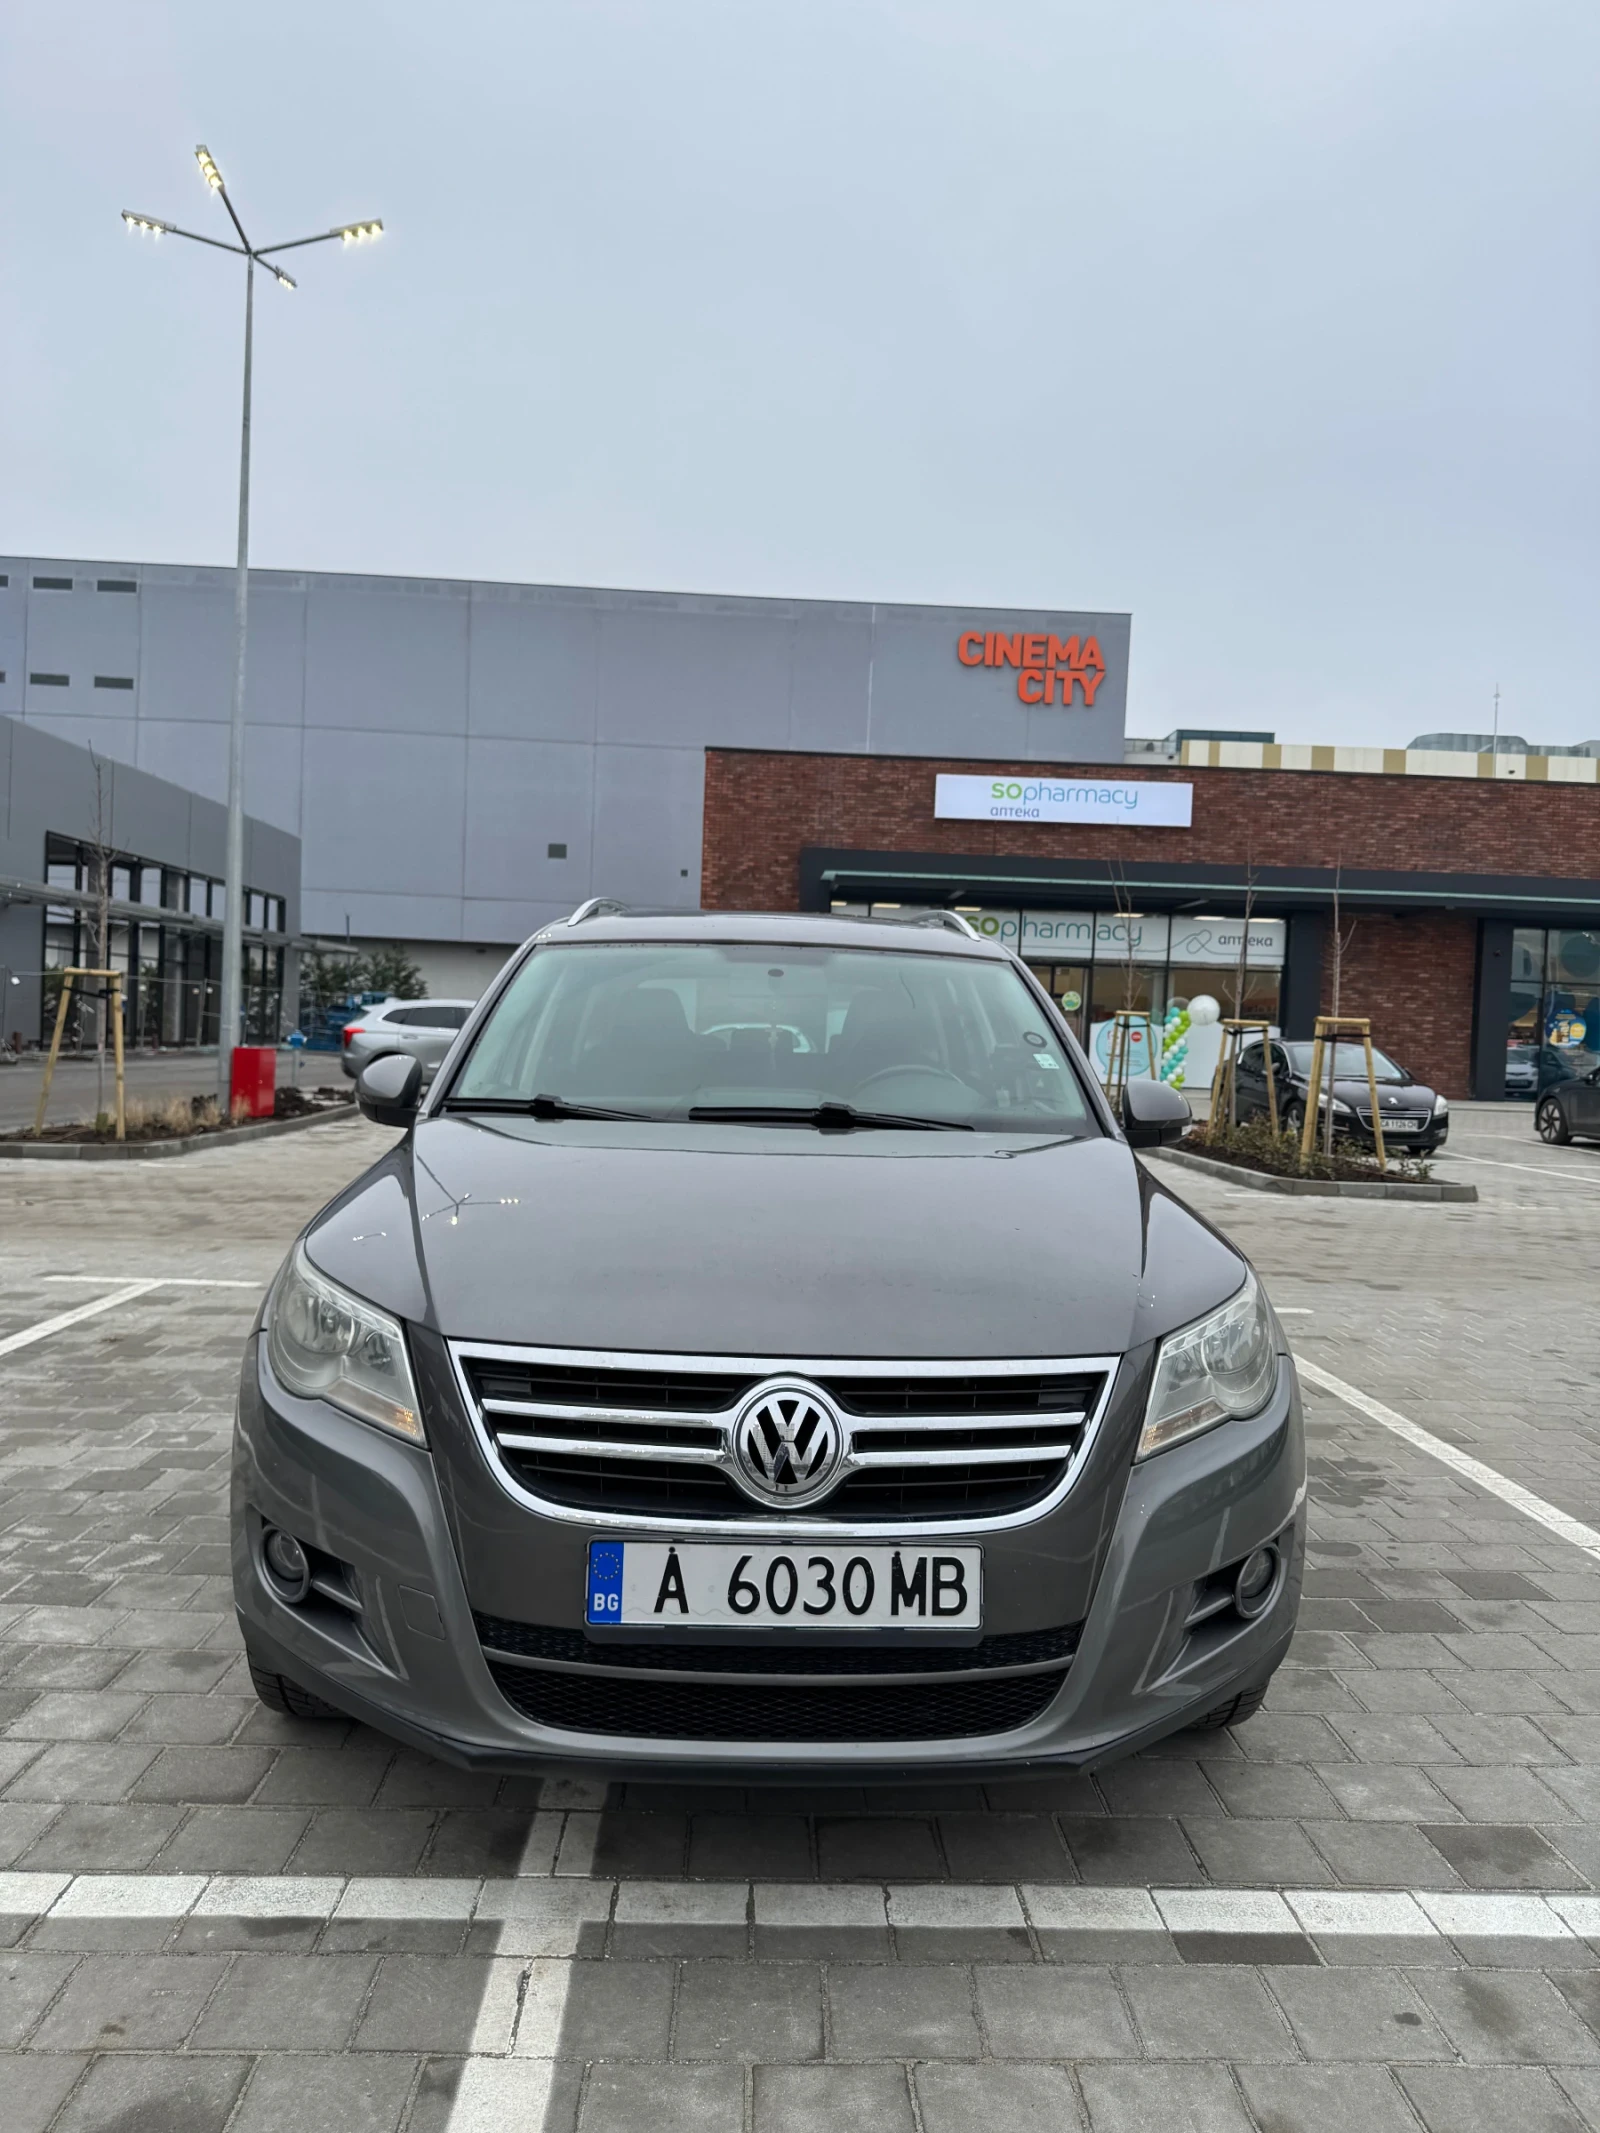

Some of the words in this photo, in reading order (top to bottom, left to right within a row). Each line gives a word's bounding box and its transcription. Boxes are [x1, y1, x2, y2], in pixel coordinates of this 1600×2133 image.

[958, 631, 1105, 671] CINEMA
[1018, 669, 1105, 706] CITY
[990, 805, 1040, 818] аптека
[593, 1593, 619, 1611] BG
[654, 1553, 689, 1613] A
[727, 1555, 875, 1615] 6030
[890, 1556, 968, 1616] MB
